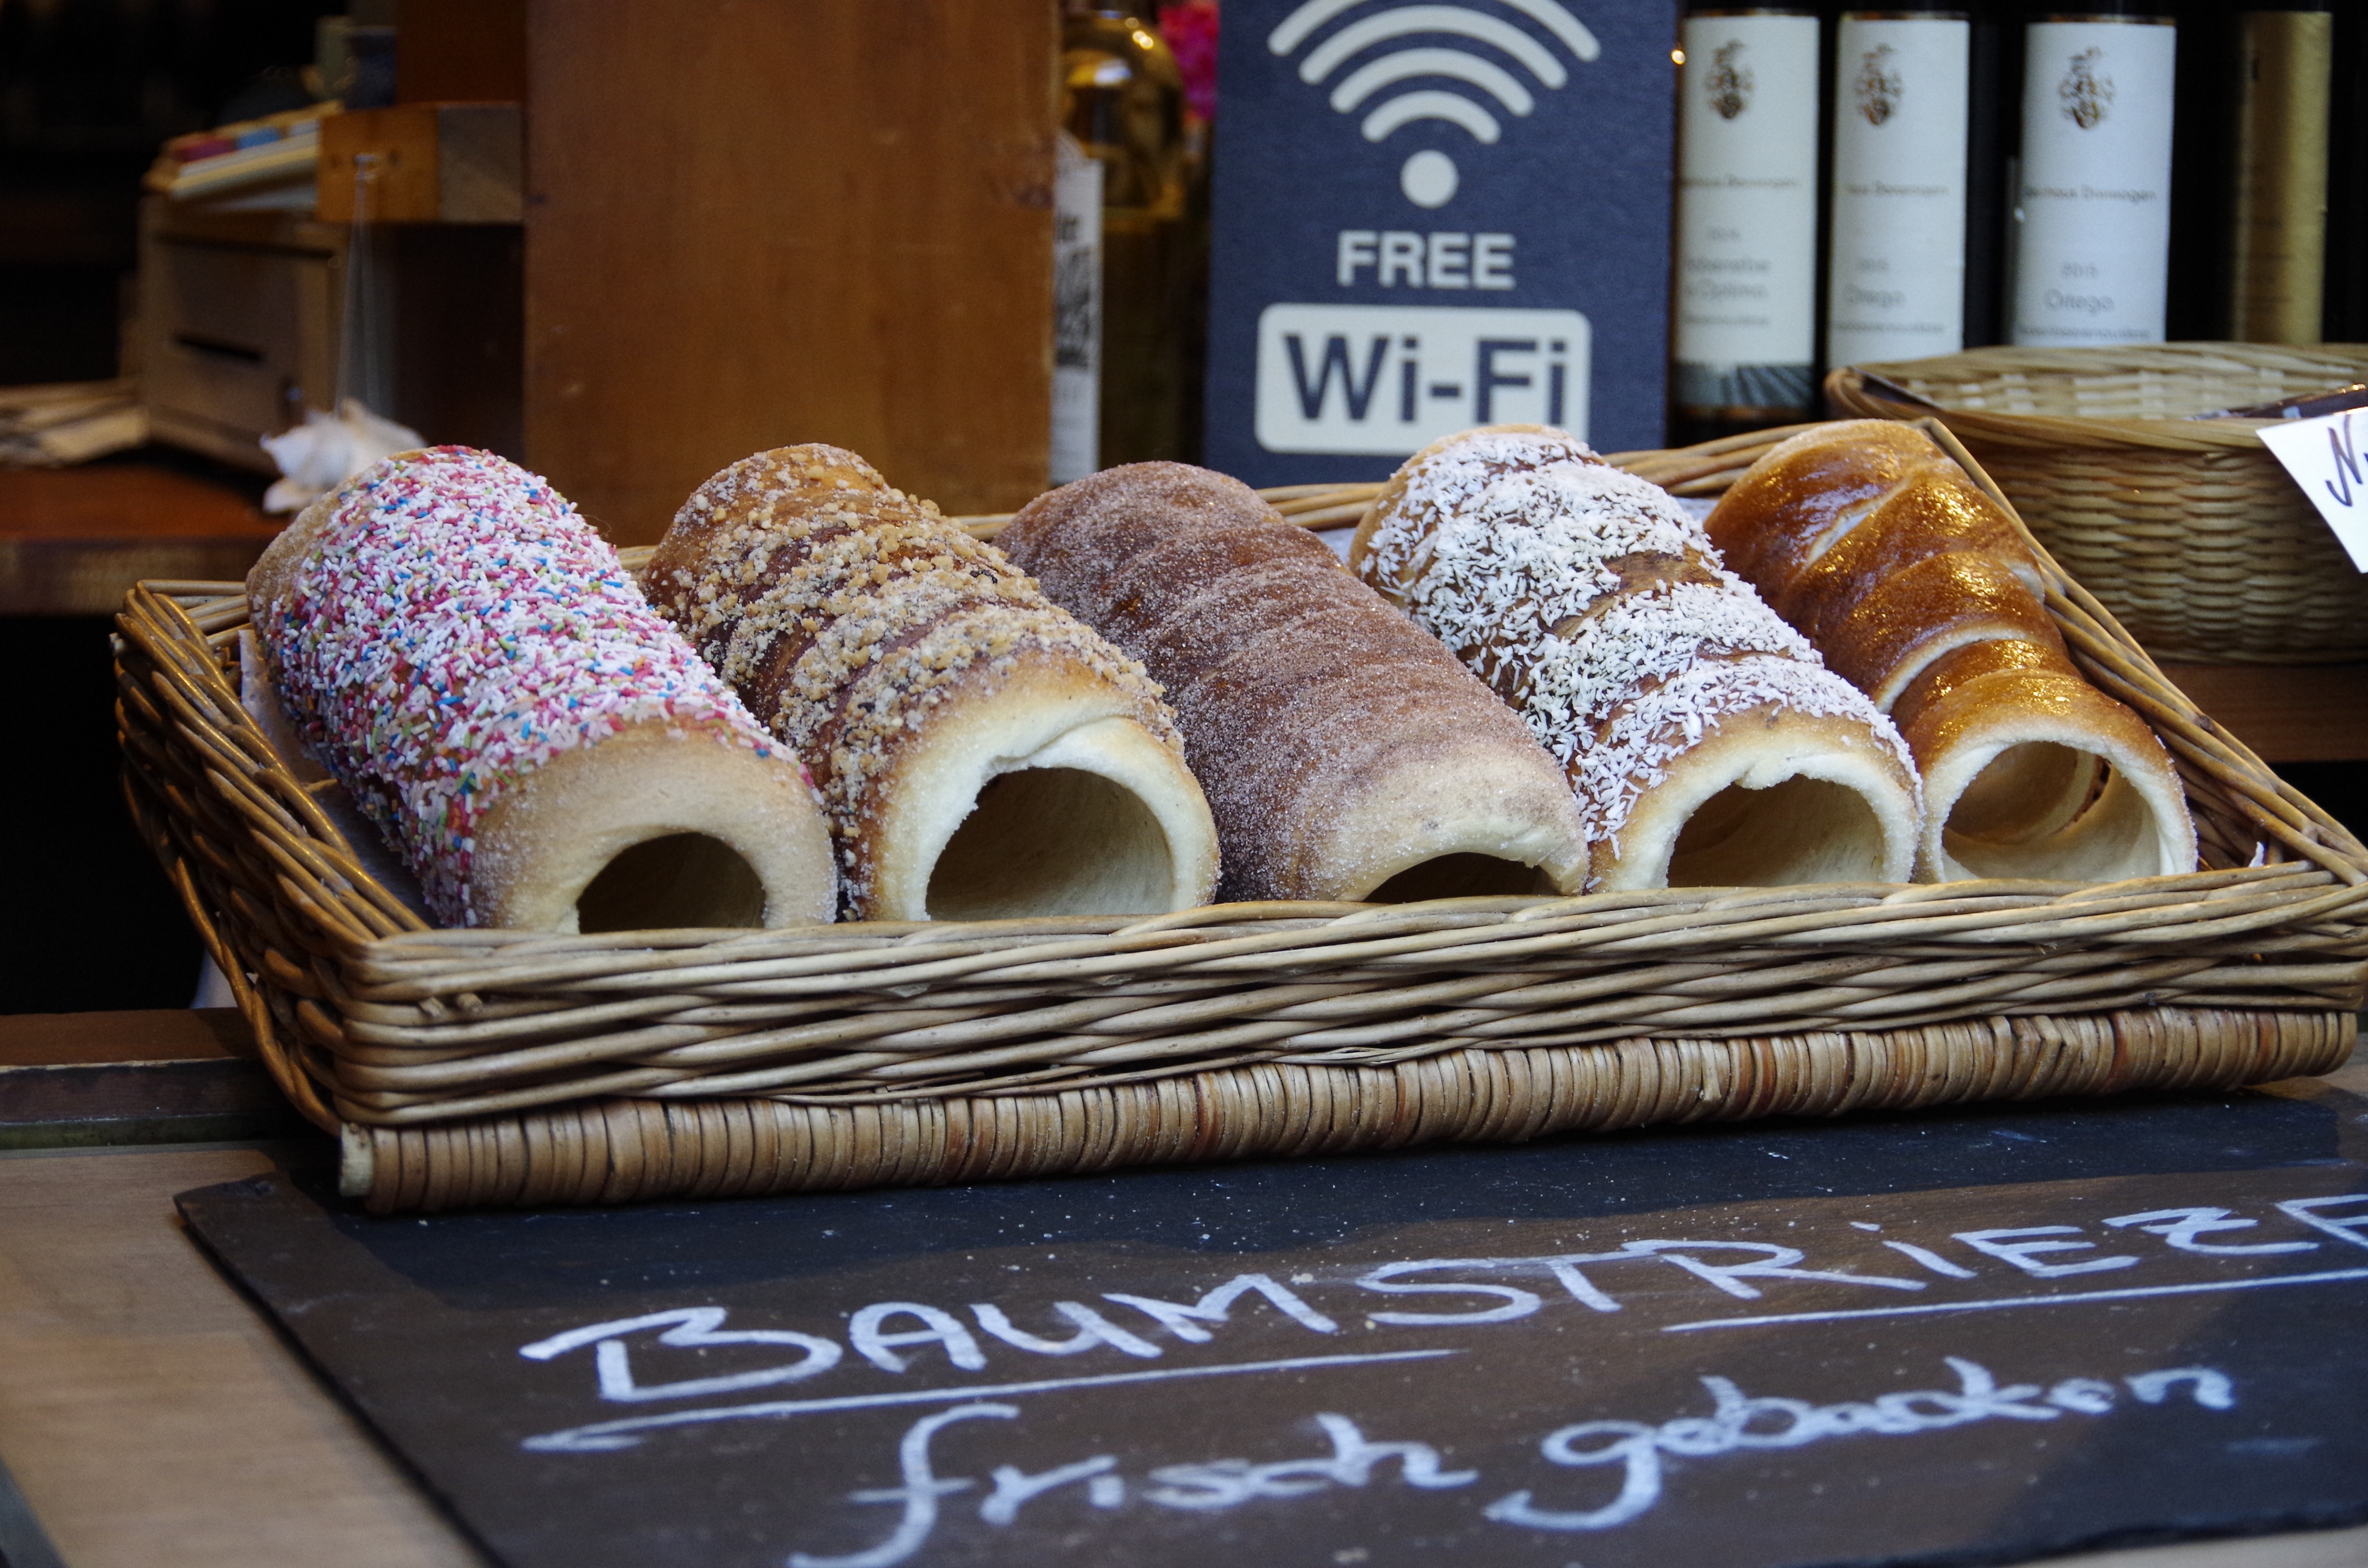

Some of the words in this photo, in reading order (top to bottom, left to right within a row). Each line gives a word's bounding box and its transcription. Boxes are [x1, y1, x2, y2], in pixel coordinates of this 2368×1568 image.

[1336, 230, 1516, 291] FREE
[1283, 333, 1568, 426] Wi-Fi
[787, 1402, 1480, 1568] frisch
[1483, 1355, 2236, 1531] gebacken
